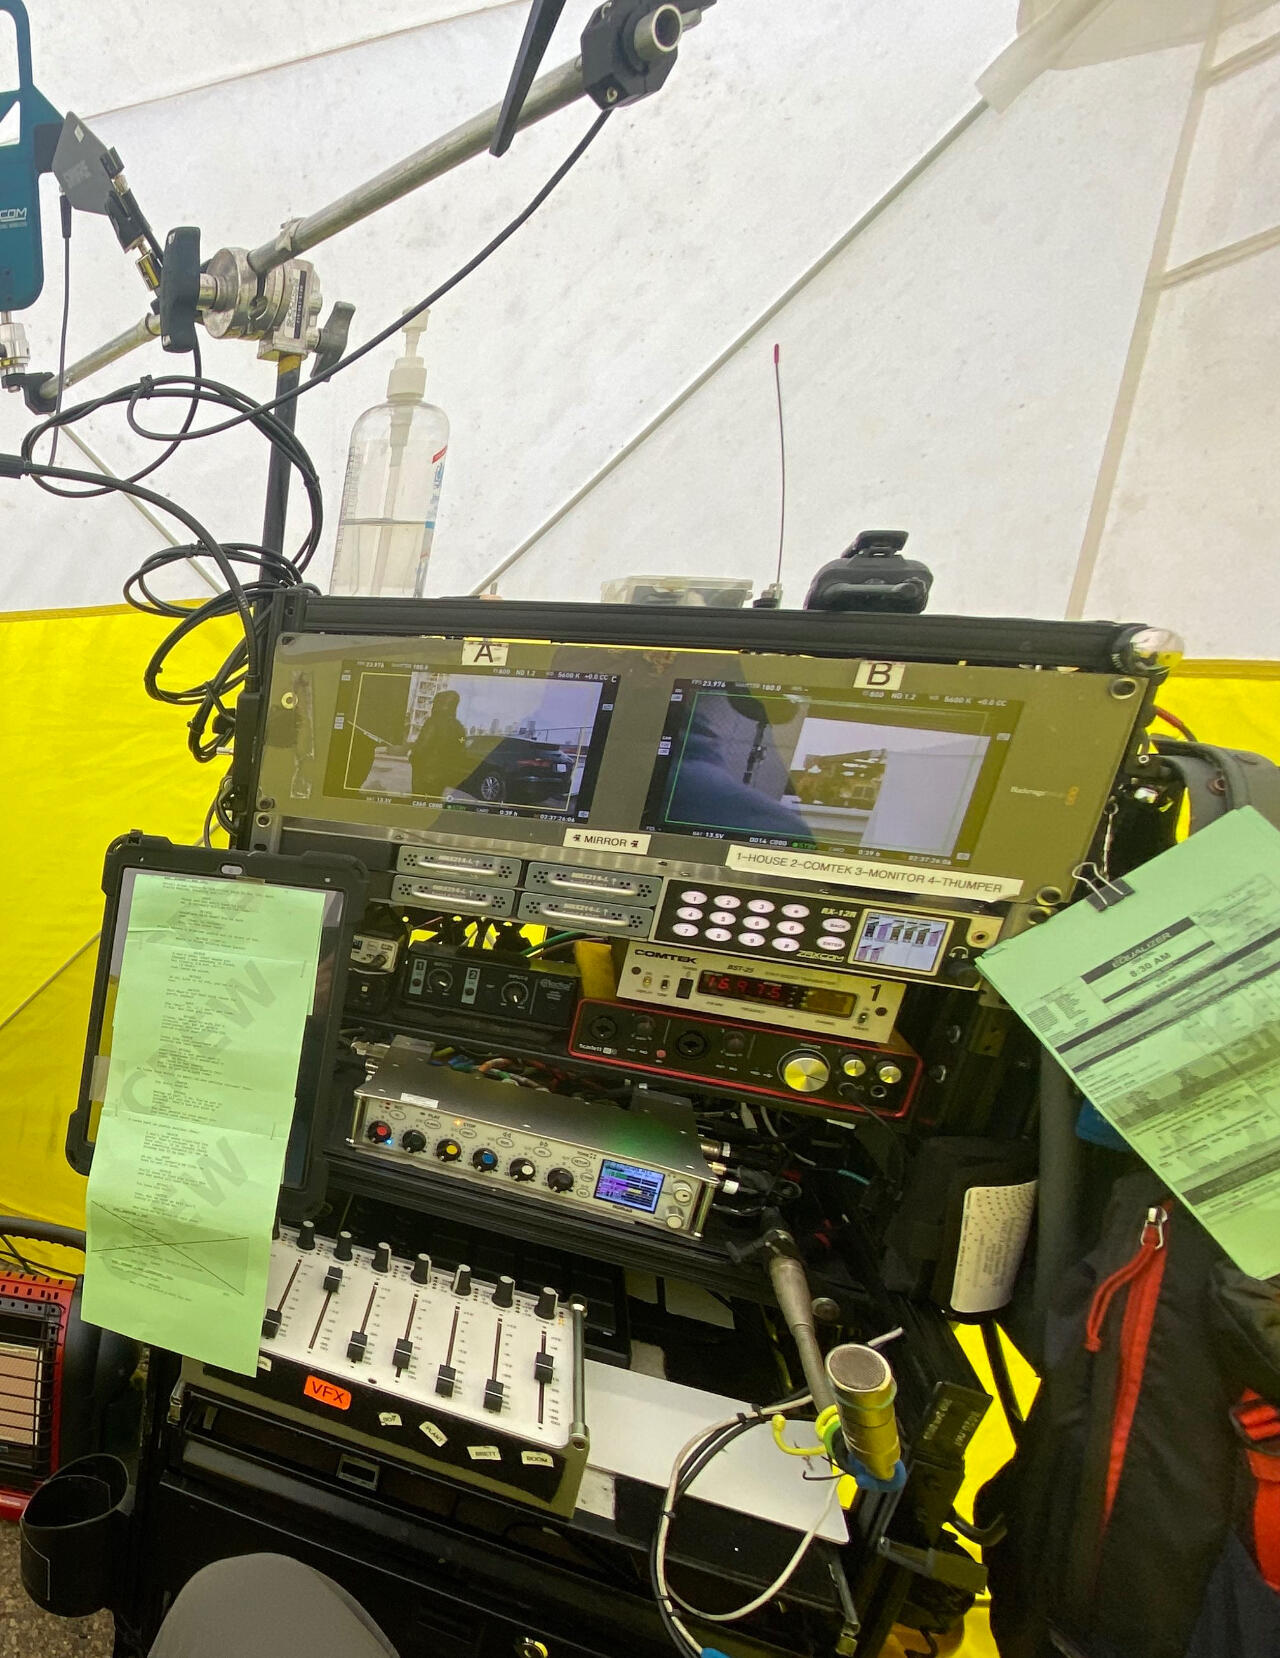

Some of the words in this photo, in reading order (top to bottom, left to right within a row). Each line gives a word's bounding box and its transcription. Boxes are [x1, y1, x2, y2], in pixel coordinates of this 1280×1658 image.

[473, 642, 493, 663] A
[867, 662, 891, 686] B
[584, 835, 627, 848] MIRROR
[737, 853, 793, 867] 1-HOUSE
[791, 859, 851, 875] 2-COMTEK
[855, 867, 925, 884] 3-MONITOR
[928, 877, 1002, 893] 4-THUMPER
[635, 949, 697, 965] COMTEK
[796, 950, 844, 962] ZAXCOM
[1112, 932, 1171, 968] EQUALIZER
[1154, 952, 1171, 965] AM
[727, 964, 755, 973] BST-25
[871, 984, 882, 1001] 1
[311, 1383, 345, 1404] VFX
